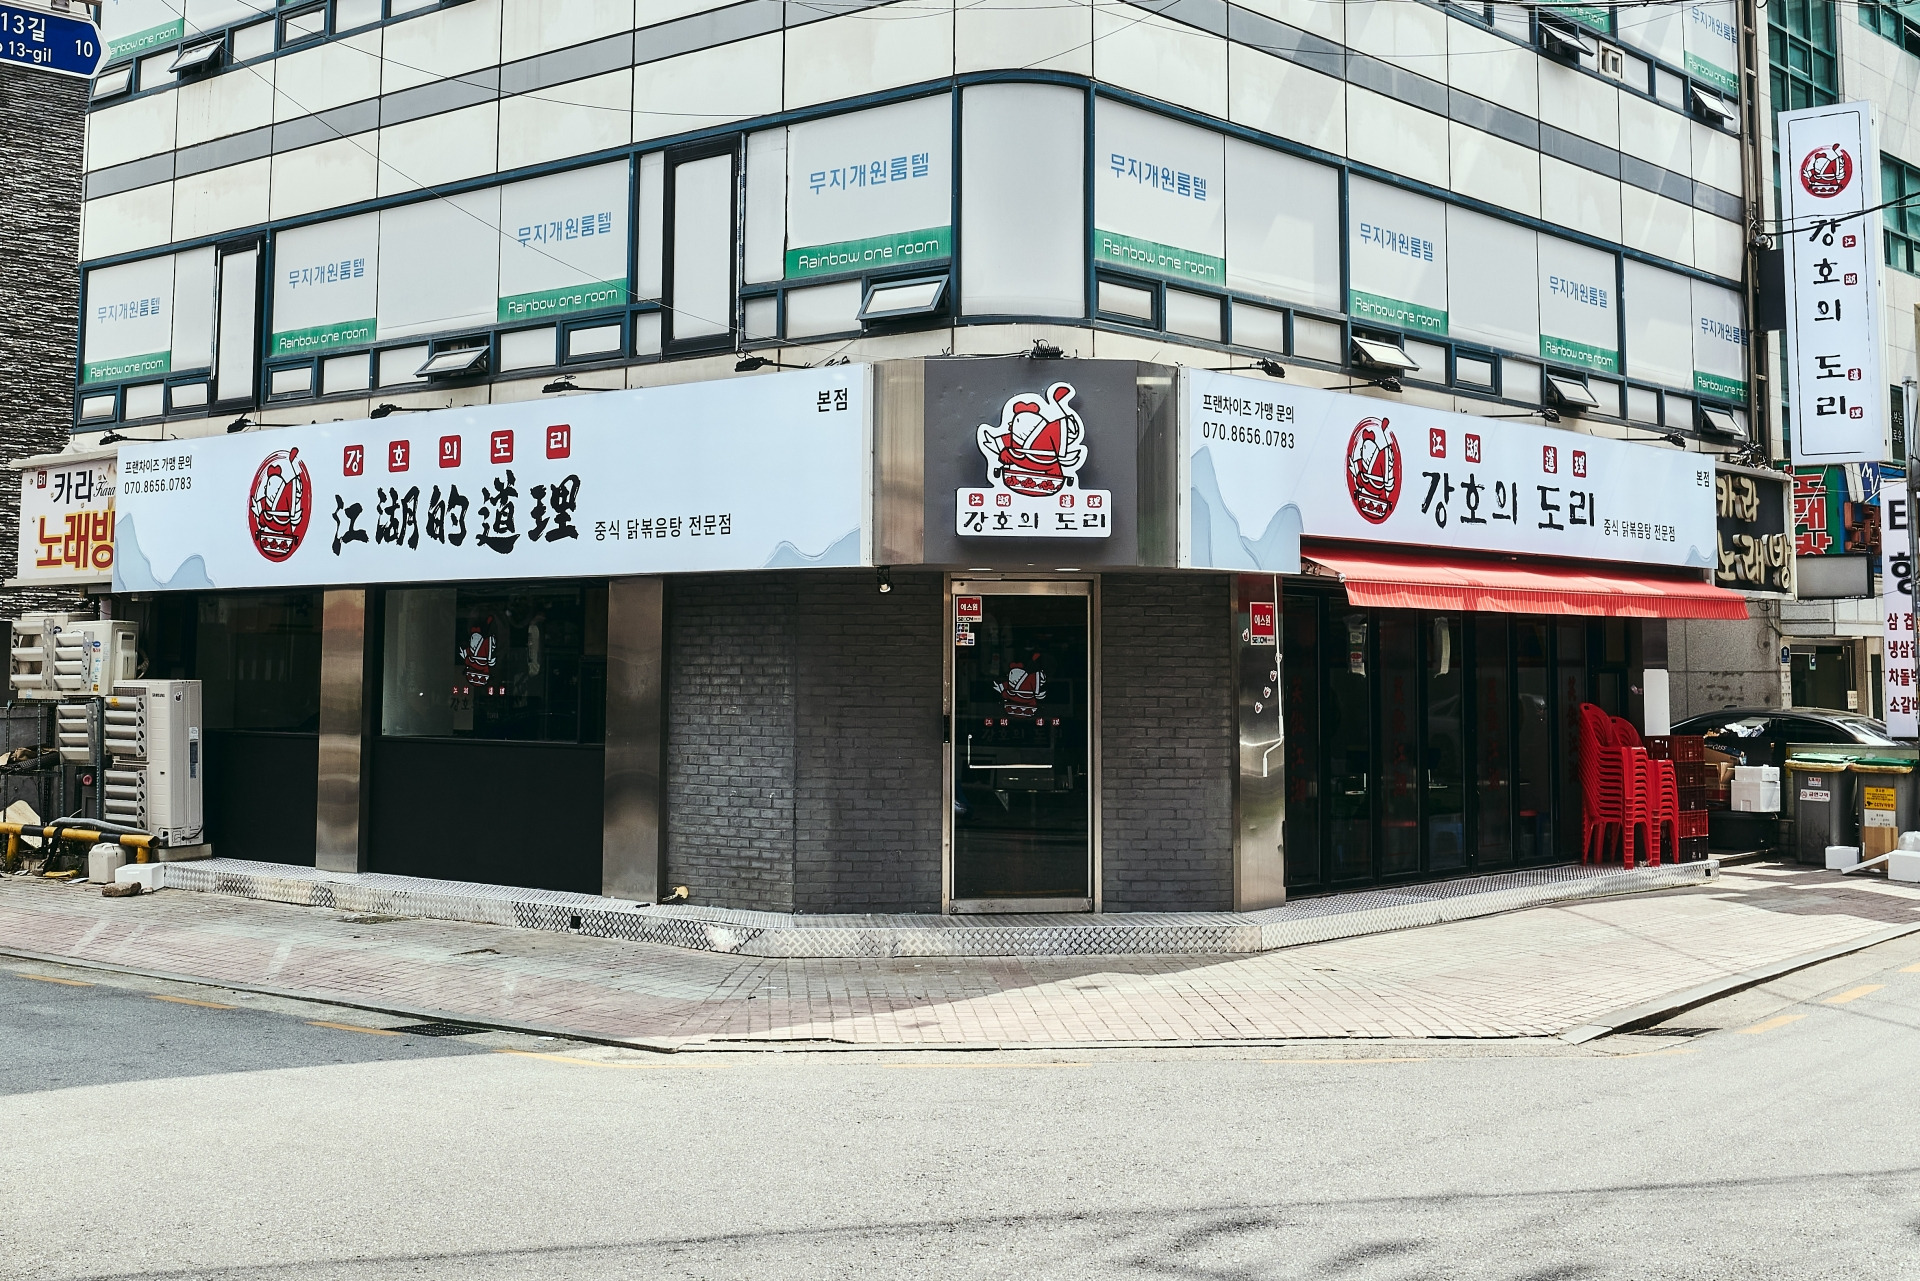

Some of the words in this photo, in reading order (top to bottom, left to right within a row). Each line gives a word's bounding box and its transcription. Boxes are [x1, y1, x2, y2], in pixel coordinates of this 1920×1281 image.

[0, 12, 46, 43] 13길
[110, 41, 137, 56] ainbow
[139, 35, 154, 47] one
[156, 27, 178, 42] room
[8, 40, 51, 63] 13-gil
[75, 39, 94, 58] 10
[810, 152, 929, 195] 무지개원룸텔
[1111, 153, 1206, 201] 무지개원룸텔
[518, 212, 612, 247] 무지개원룸텔
[1360, 222, 1433, 262] 무지개원룸텔
[798, 250, 860, 270] Rainbow
[864, 247, 892, 261] one
[897, 240, 939, 256] room
[1103, 238, 1156, 264] Rainbow
[1158, 254, 1181, 270] one
[1184, 261, 1216, 277] room
[288, 258, 365, 289] 무지개원룸텔
[1809, 219, 1841, 321] 강호의
[508, 298, 556, 315] Rainbow
[559, 296, 581, 307] one
[584, 289, 618, 303] room
[1550, 275, 1608, 309] 무지개원룸텔
[97, 297, 160, 323] 무지개원룸텔
[1355, 296, 1395, 318] Rainbow
[1397, 310, 1415, 323] one
[1416, 314, 1441, 328] room
[279, 335, 319, 350] Rainbow
[321, 332, 339, 343] one
[342, 328, 368, 340] room
[1545, 340, 1578, 358] Rainbow
[1579, 350, 1593, 362] one
[1594, 354, 1614, 367] room
[90, 362, 124, 378] Rainbow
[124, 361, 140, 374] one
[142, 357, 164, 371] room
[1697, 376, 1724, 392] Rainbow
[1725, 384, 1736, 395] one
[1815, 354, 1846, 416] 도리
[816, 387, 848, 413] 본점
[1203, 394, 1252, 417] 프랜차이즈
[1255, 401, 1273, 420] 가맹
[1276, 404, 1294, 424] 문의
[1203, 421, 1295, 449] 070.8656.0783
[125, 459, 160, 475] 프랜차이즈
[161, 457, 176, 472] 가맹
[178, 454, 192, 470] 문의
[1696, 469, 1710, 488] 본점
[38, 473, 46, 487] B1
[53, 470, 94, 504] 카라
[124, 476, 192, 495] 070.8656.0783
[332, 469, 581, 556] 江湖的道理
[1421, 470, 1518, 530] 강호의
[1536, 484, 1595, 531] 도리
[1716, 473, 1761, 523] 카라
[594, 519, 620, 541] 중식
[626, 516, 682, 540] 닭볶음탕
[688, 513, 731, 537] 전문점
[963, 511, 1039, 533] 강호의
[1055, 512, 1106, 531] 도리
[1604, 518, 1619, 537] 중식
[1621, 520, 1652, 540] 닭볶음탕
[1654, 524, 1676, 542] 전문점
